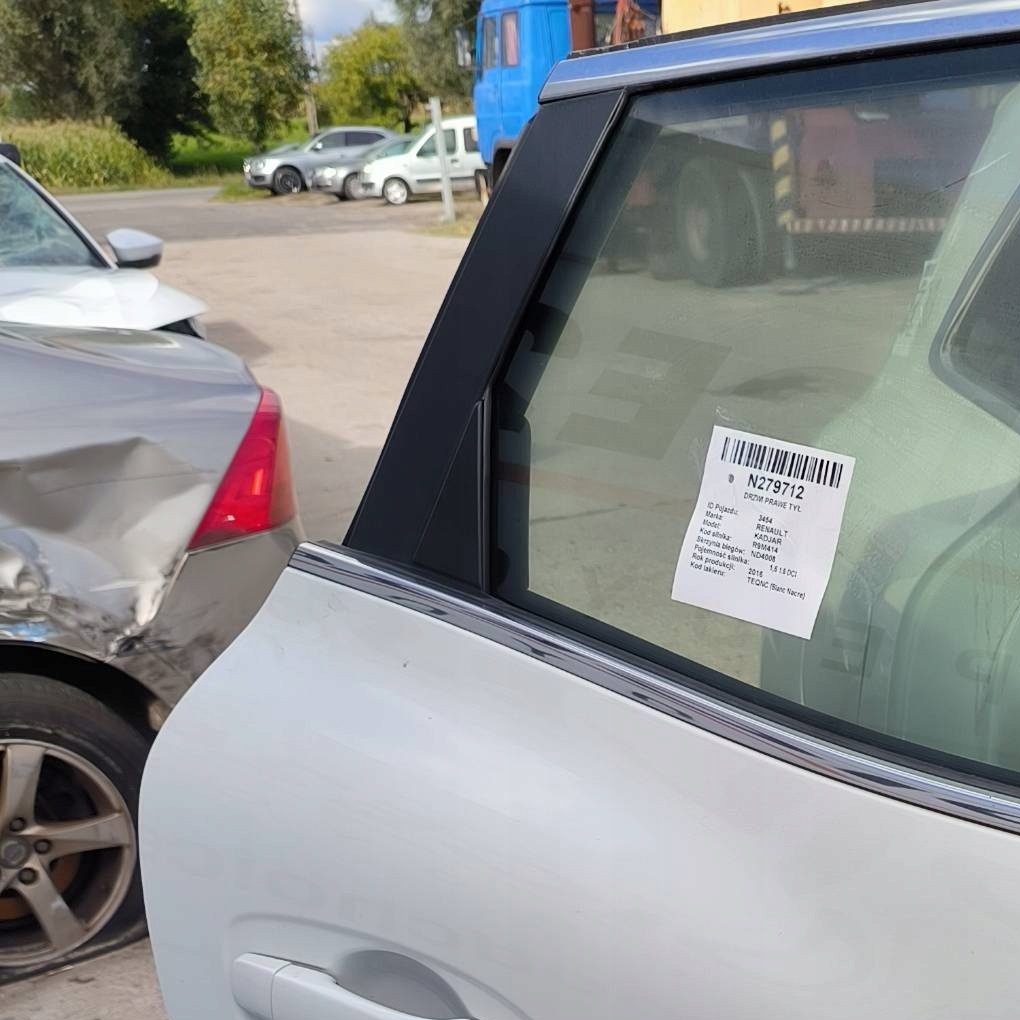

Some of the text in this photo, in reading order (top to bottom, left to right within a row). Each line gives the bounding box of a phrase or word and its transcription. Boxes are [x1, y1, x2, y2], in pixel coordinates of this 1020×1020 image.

[748, 473, 805, 500] N279712
[744, 492, 764, 503] DRZWI
[764, 497, 788, 509] PRAWE
[700, 527, 711, 536] Kod
[756, 524, 788, 537] RENAULT
[754, 532, 782, 546] KADJAR
[690, 560, 702, 570] Kod
